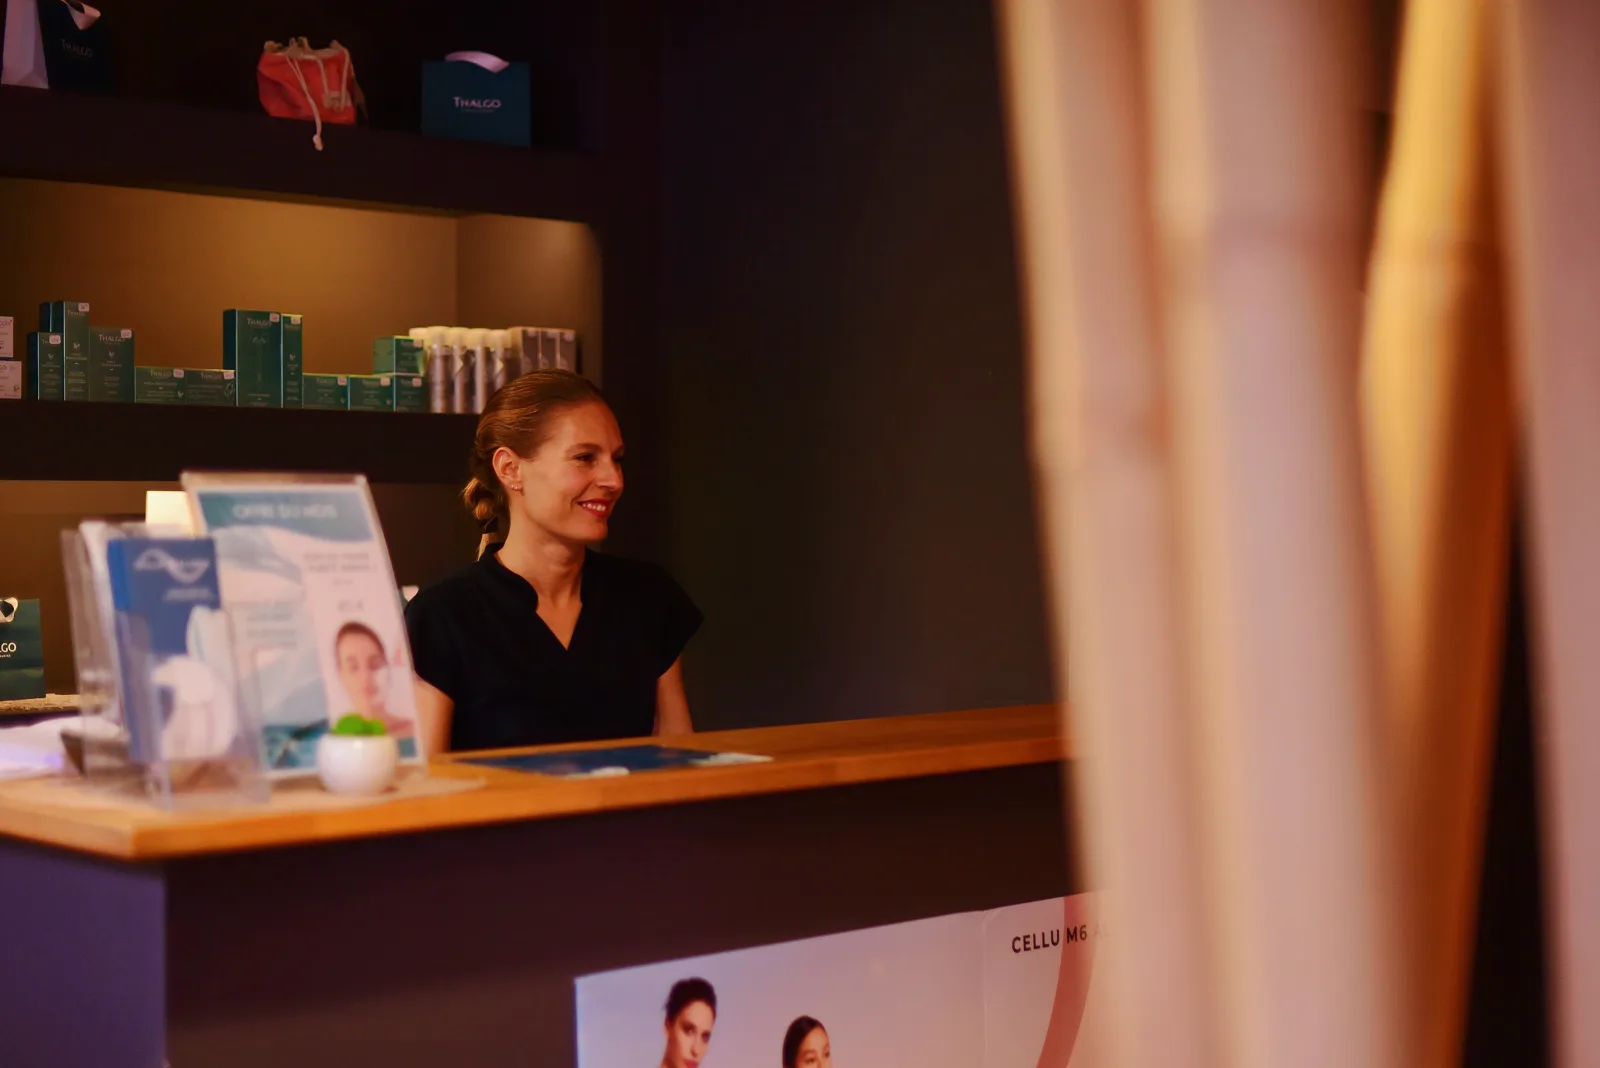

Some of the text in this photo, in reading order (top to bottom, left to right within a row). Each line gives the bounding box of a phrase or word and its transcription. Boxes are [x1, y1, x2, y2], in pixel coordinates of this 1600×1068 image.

[59, 39, 93, 58] THALGO
[453, 97, 501, 108] THALGO
[98, 334, 125, 343] THALGO
[1012, 929, 1060, 953] CELLU
[1066, 925, 1088, 944] M6
